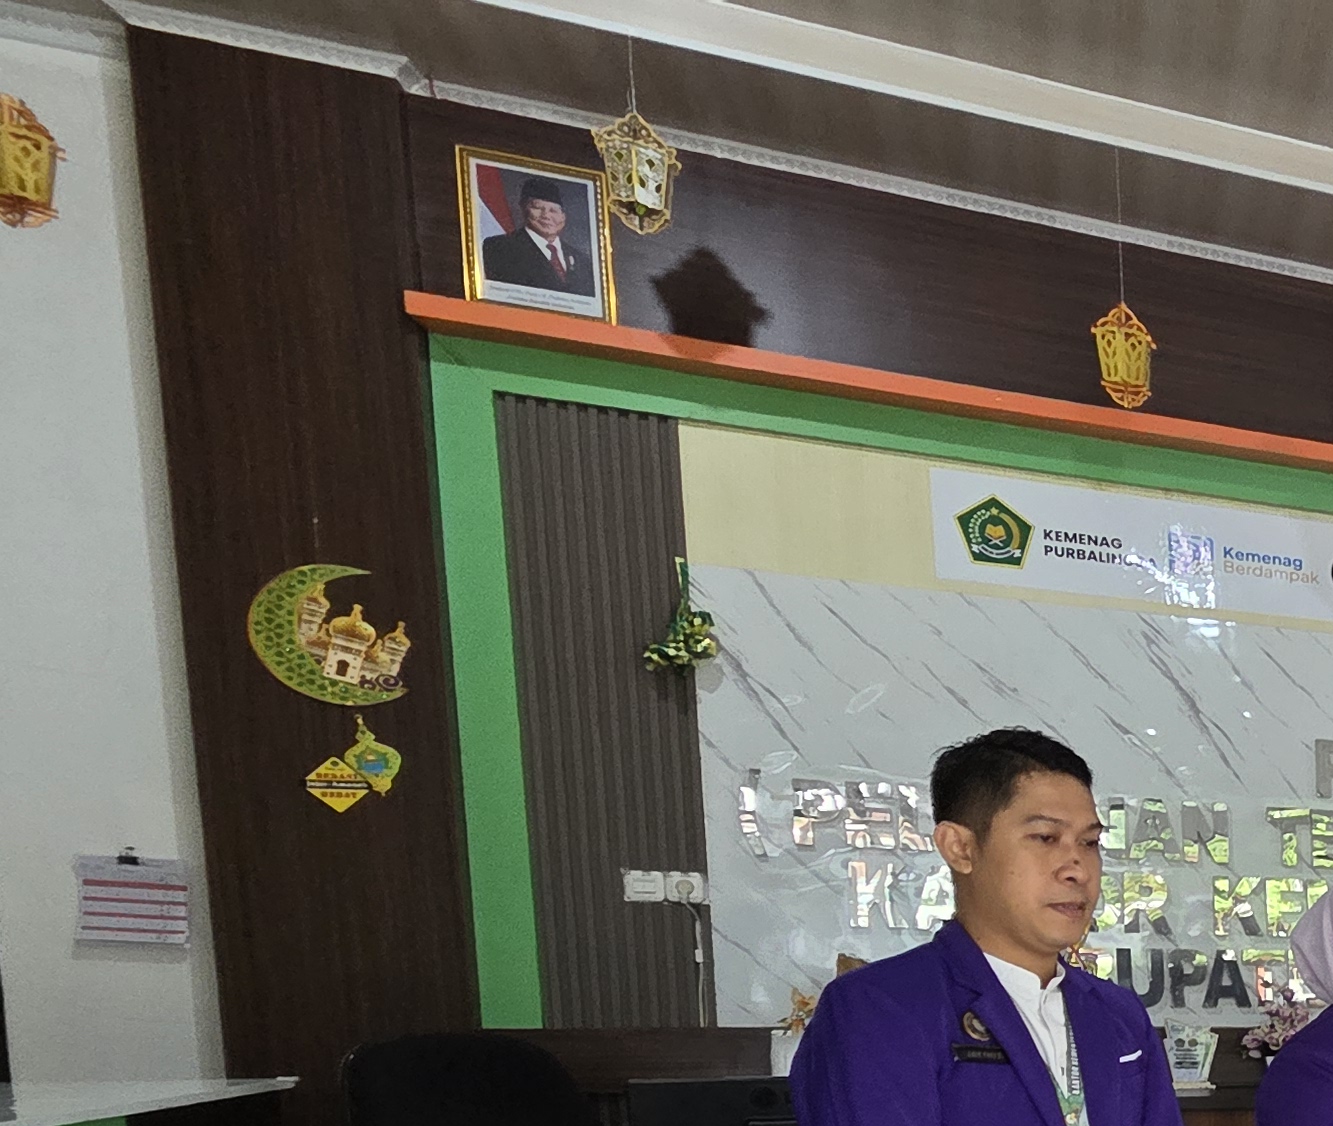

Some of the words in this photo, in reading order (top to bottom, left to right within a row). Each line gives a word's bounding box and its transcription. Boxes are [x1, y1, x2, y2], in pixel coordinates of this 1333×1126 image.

[1043, 529, 1123, 549] KEMENAG
[1223, 546, 1303, 571] Kemenag
[1223, 560, 1320, 585] Berdampak
